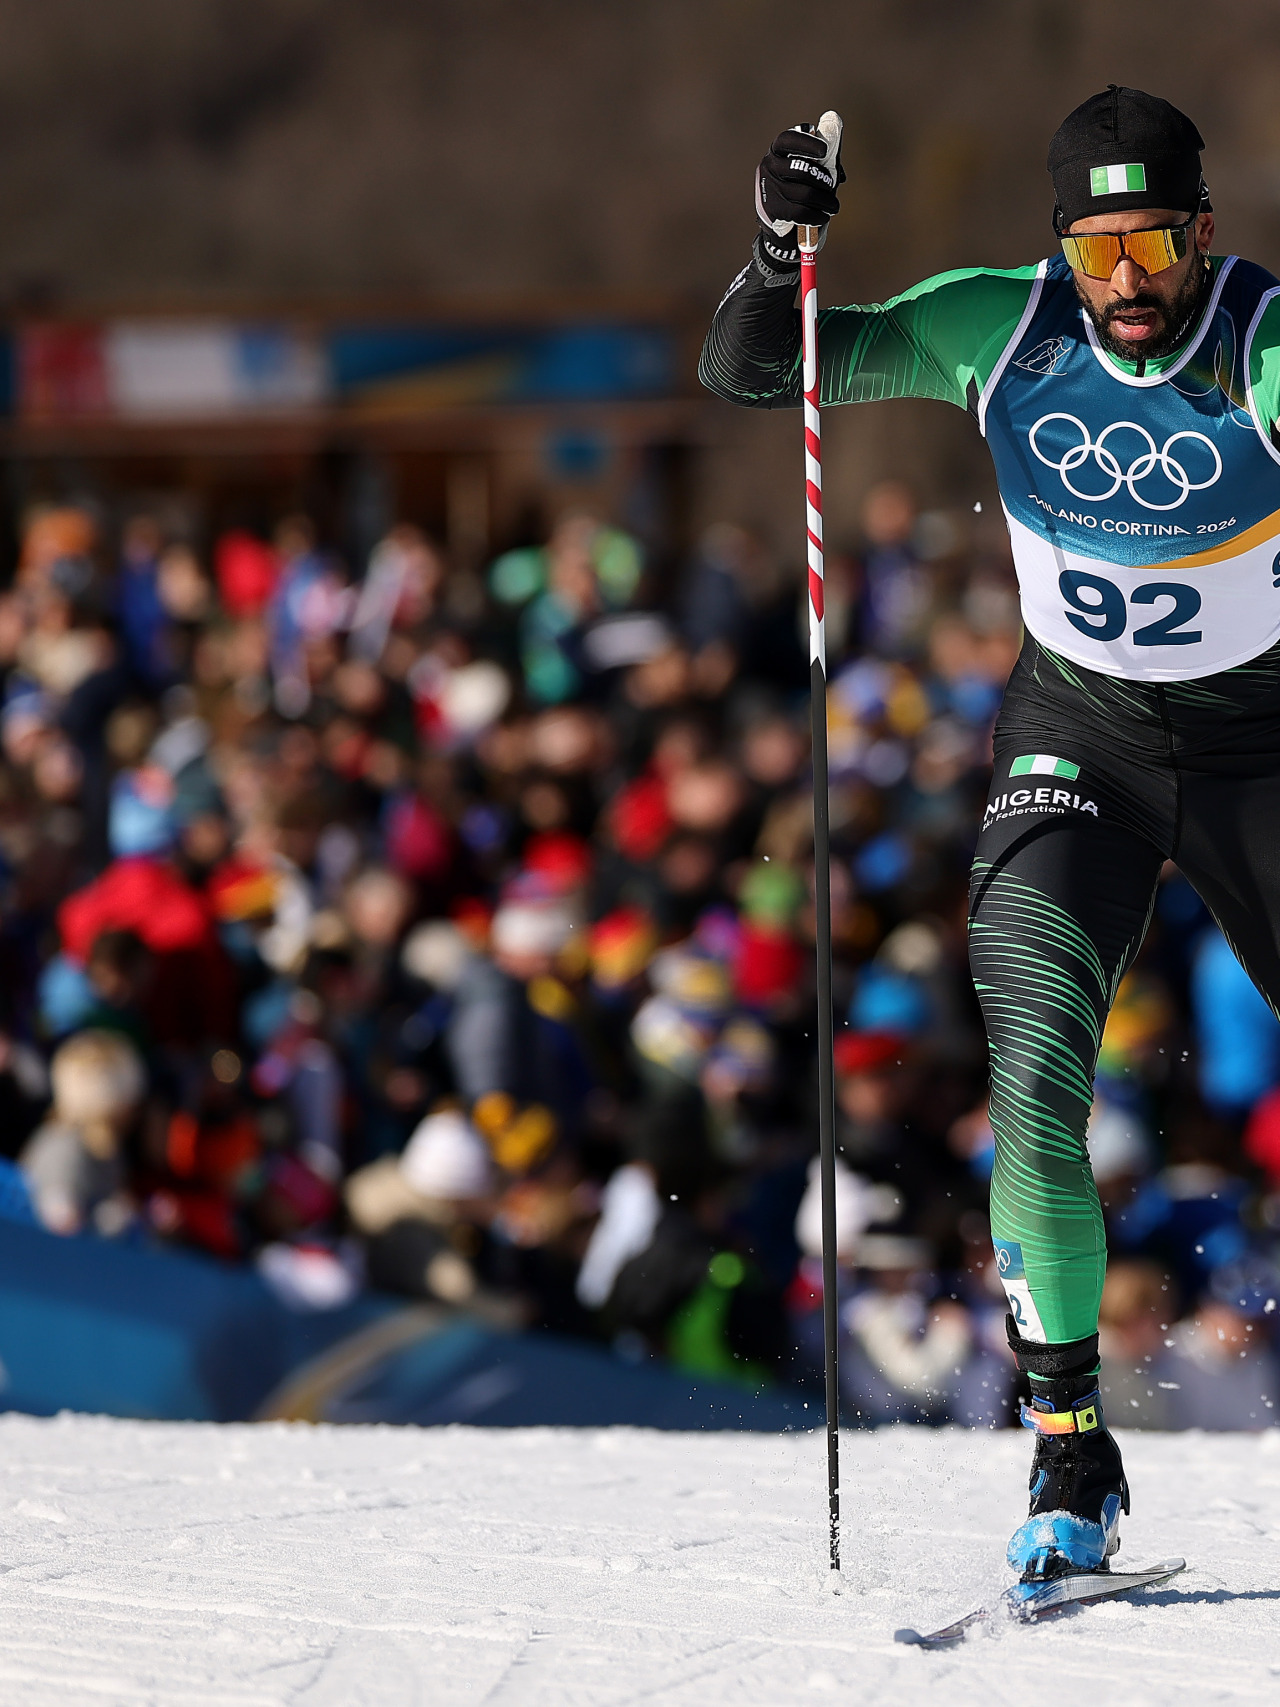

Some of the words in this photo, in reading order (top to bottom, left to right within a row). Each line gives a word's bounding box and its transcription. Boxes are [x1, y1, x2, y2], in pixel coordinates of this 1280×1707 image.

[1027, 494, 1097, 528] MILANO
[1101, 519, 1191, 536] CORTINA
[1196, 516, 1237, 534] 2026
[1058, 569, 1203, 646] 92
[983, 788, 1098, 821] NIGERIA
[996, 805, 1065, 821] Federation
[1009, 1293, 1027, 1326] 2
